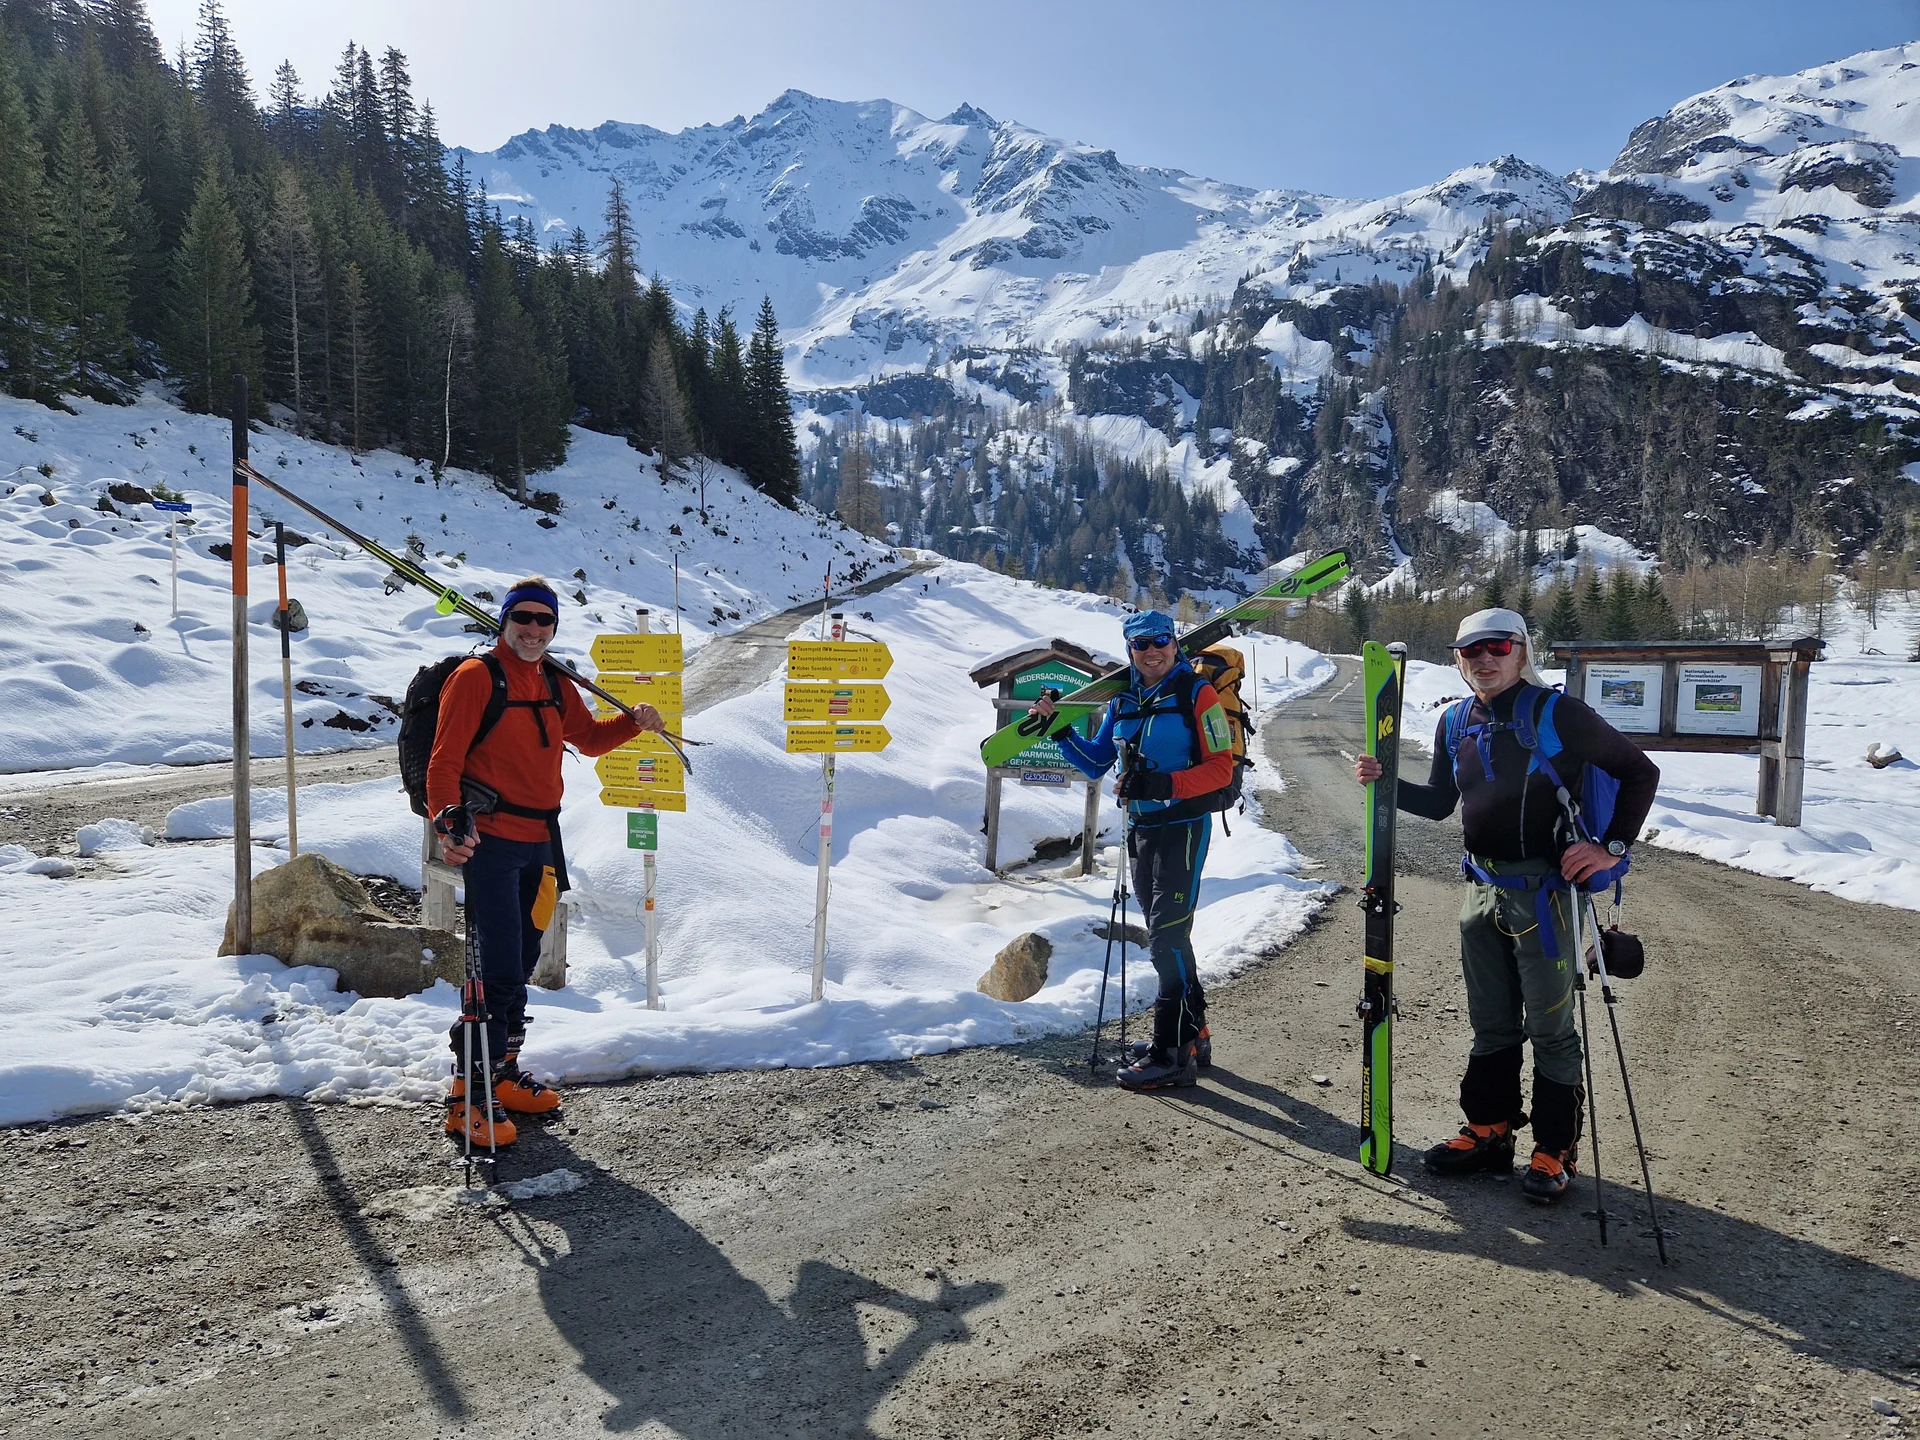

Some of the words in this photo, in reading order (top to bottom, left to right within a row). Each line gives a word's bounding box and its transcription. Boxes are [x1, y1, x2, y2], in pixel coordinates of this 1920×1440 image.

[1378, 714, 1395, 741] K2
[1142, 1068, 1185, 1085] DYNAFIT
[1363, 1066, 1371, 1127] WAYBACK
